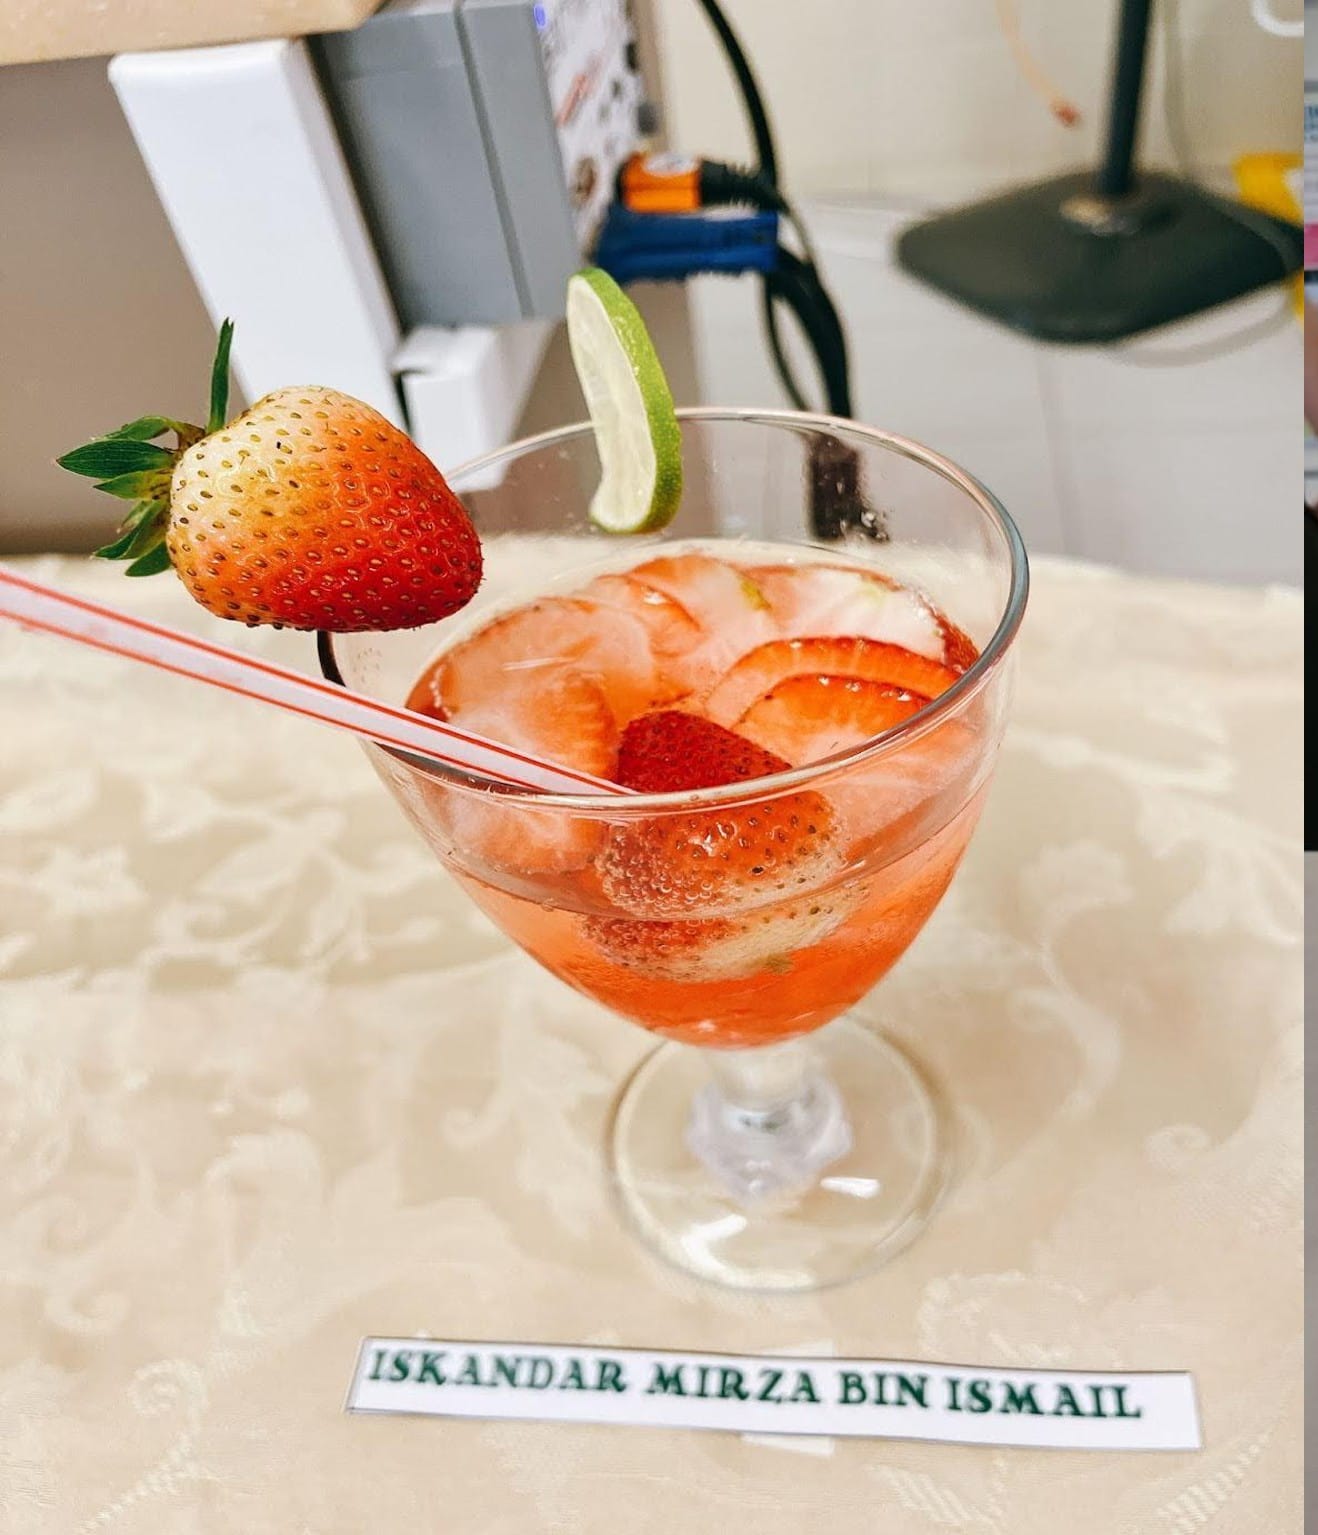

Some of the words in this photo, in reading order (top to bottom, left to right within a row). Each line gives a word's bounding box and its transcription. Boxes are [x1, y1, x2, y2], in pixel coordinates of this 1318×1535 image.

[367, 1350, 627, 1393] ISKANDAR
[646, 1364, 820, 1404] MIRZA
[838, 1371, 929, 1409] BIN
[945, 1378, 1142, 1419] ISMAIL
